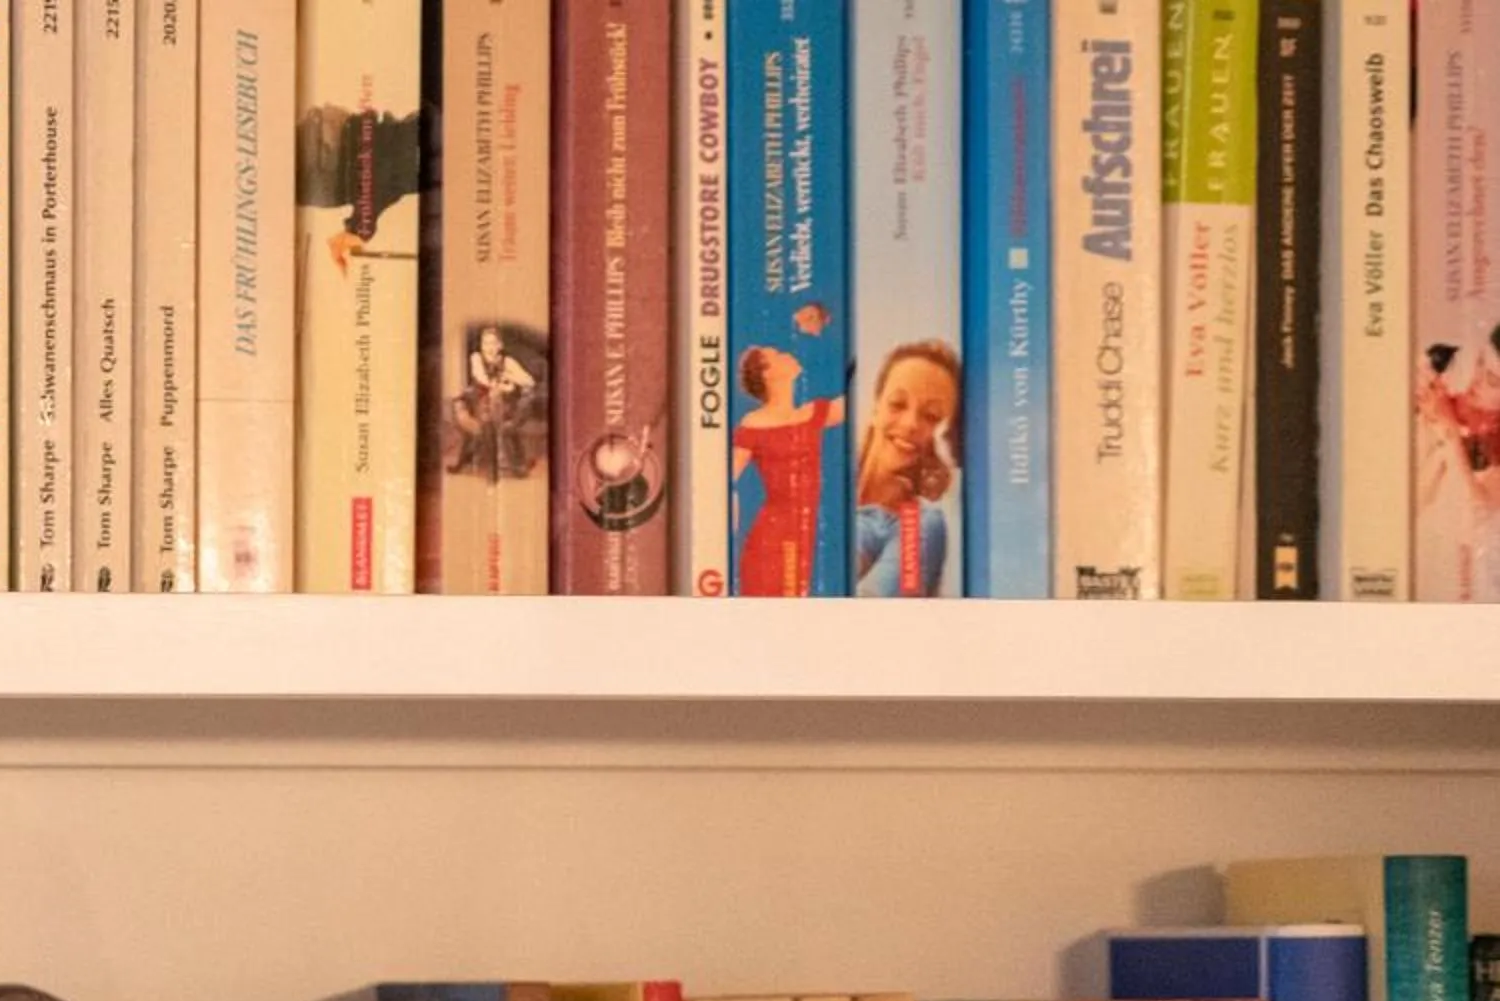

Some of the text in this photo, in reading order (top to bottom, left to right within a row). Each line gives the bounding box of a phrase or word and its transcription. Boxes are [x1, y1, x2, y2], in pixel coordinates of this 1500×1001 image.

[231, 29, 259, 357] DAS FRÜHLINGS-LESEBUCH
[476, 32, 492, 263] SUSAN ELIZABETH PHILLIPS
[698, 57, 721, 429] FOGLE DRUGSTORE COWBOY
[764, 52, 784, 292] SUSAN ELIZABETH PHILLIPS
[789, 37, 814, 291] Verliebt, verheiratet
[1080, 39, 1133, 261] Aufschrei
[1281, 73, 1295, 280] DAS ANDERE UFER ZEIT
[1365, 53, 1385, 337] Eva Völler Das Chaosweib
[40, 107, 59, 549] Tom Sharpe in Porterhouse
[353, 264, 374, 473] Susan Elizabeth Phillips
[606, 115, 628, 425] SUSAN PHILLIPS Bleib nicht zum
[1007, 279, 1032, 484] Ildikó von Kürthy
[1095, 282, 1124, 464] Truddi Chase
[1185, 326, 1208, 378] Eva
[97, 298, 118, 550] Tom Sharpe Alles Quatsch
[160, 305, 178, 554] Tom Sharpe Puppenmord
[1421, 908, 1447, 975] Tenzer
